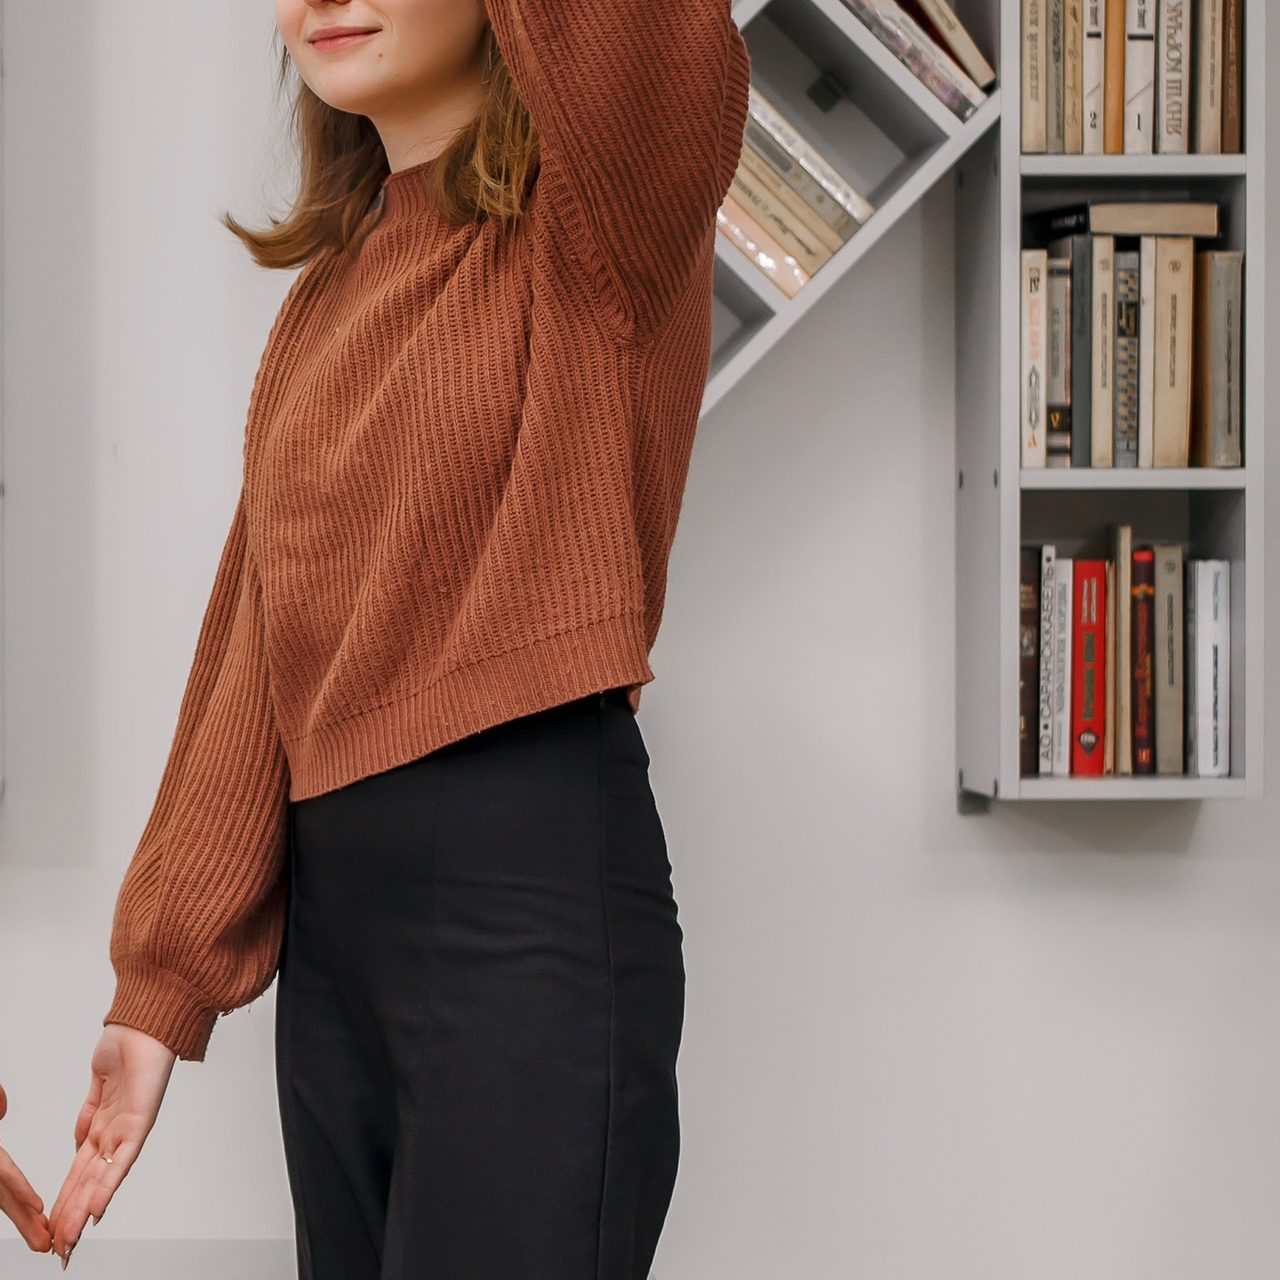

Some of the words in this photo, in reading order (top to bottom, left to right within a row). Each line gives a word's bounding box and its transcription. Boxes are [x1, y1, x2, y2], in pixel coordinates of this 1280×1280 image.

[1165, 0, 1182, 73] КОРЧАК
[1090, 112, 1097, 129] 2
[1137, 113, 1141, 130] 1
[1165, 78, 1182, 135] ЯНУШ
[1040, 566, 1053, 719] САРАНСККАБЕЛЬ
[1040, 734, 1052, 761] АО
